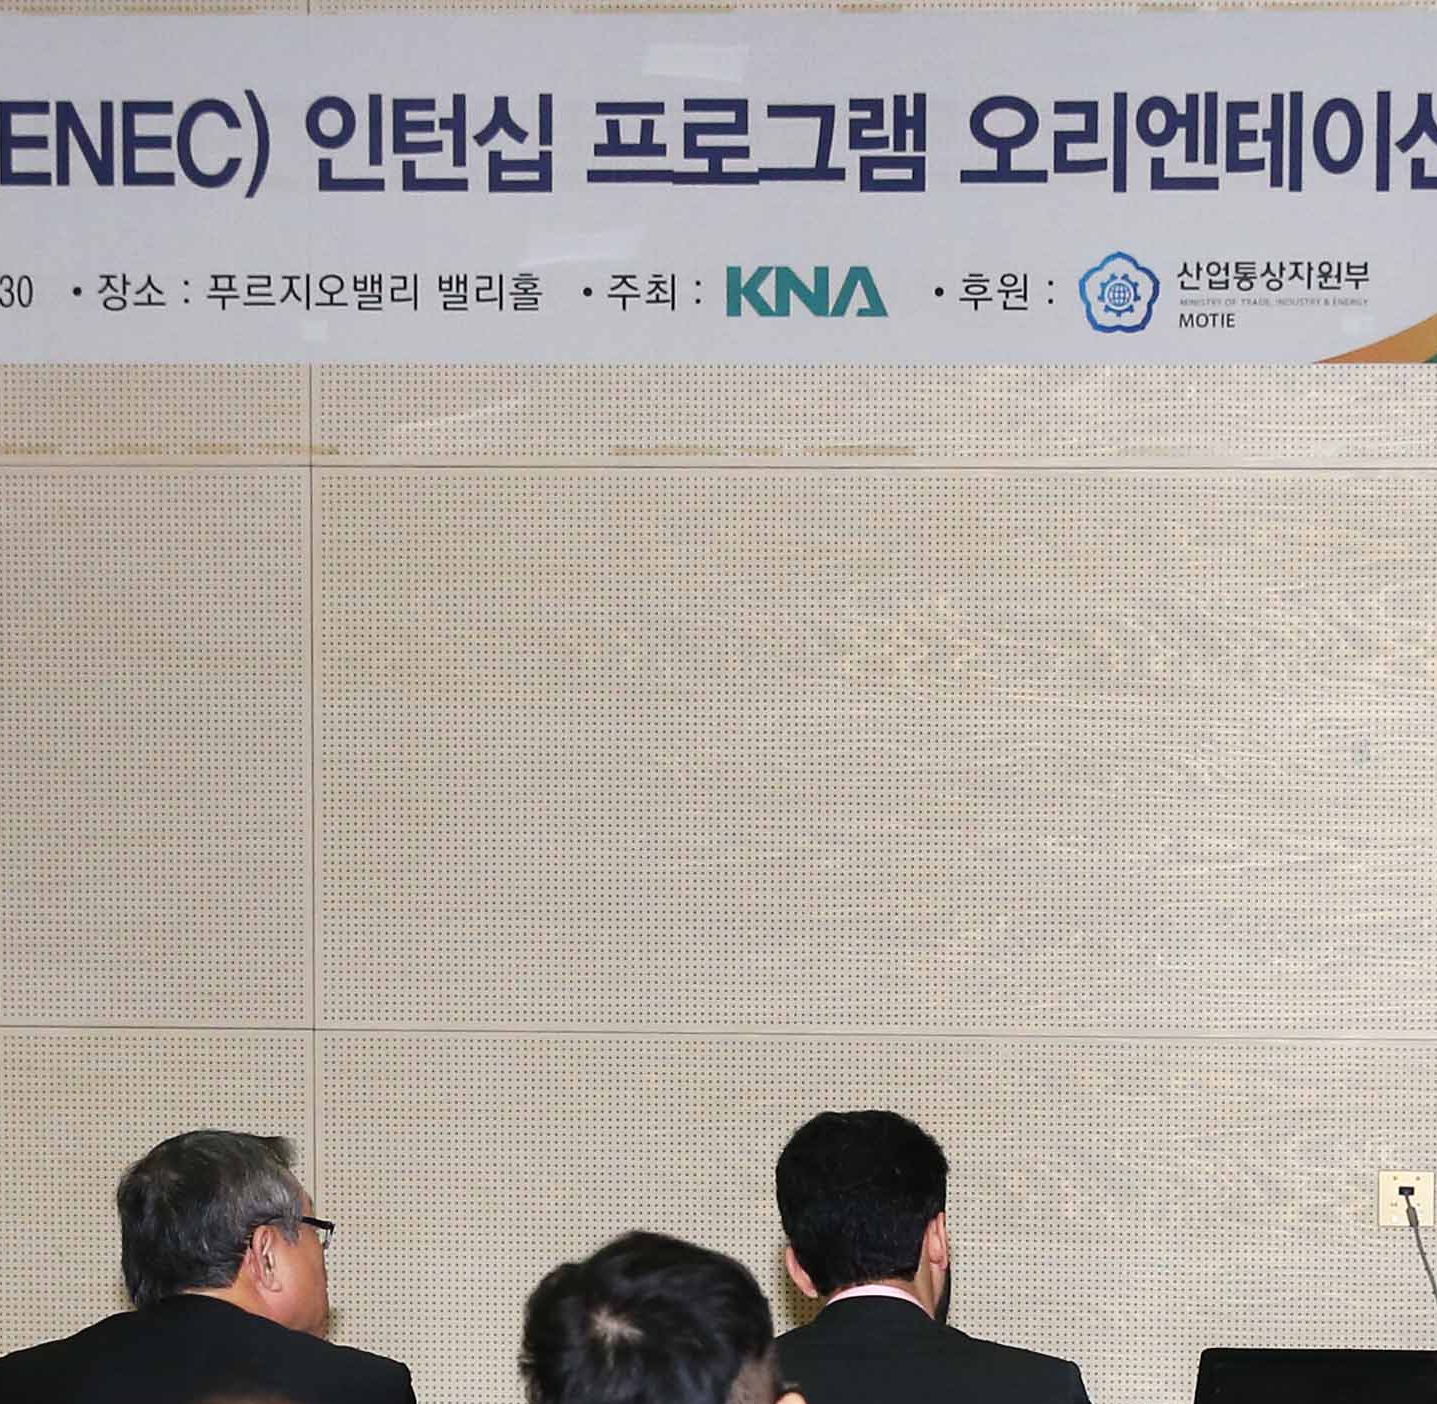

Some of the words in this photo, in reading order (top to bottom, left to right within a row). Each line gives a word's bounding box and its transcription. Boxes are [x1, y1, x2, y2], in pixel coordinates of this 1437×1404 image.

[304, 92, 553, 193] 인턴십
[586, 92, 927, 193] 프로그램
[97, 272, 167, 312] 장소
[206, 272, 418, 312] 푸르지오밸리
[438, 273, 544, 312] 밸리홀
[606, 273, 676, 312] 주최
[725, 265, 889, 318] KNA
[958, 272, 1029, 312] 후원
[1176, 260, 1370, 293] 산업통상자원부
[1178, 312, 1236, 329] MOTIE
